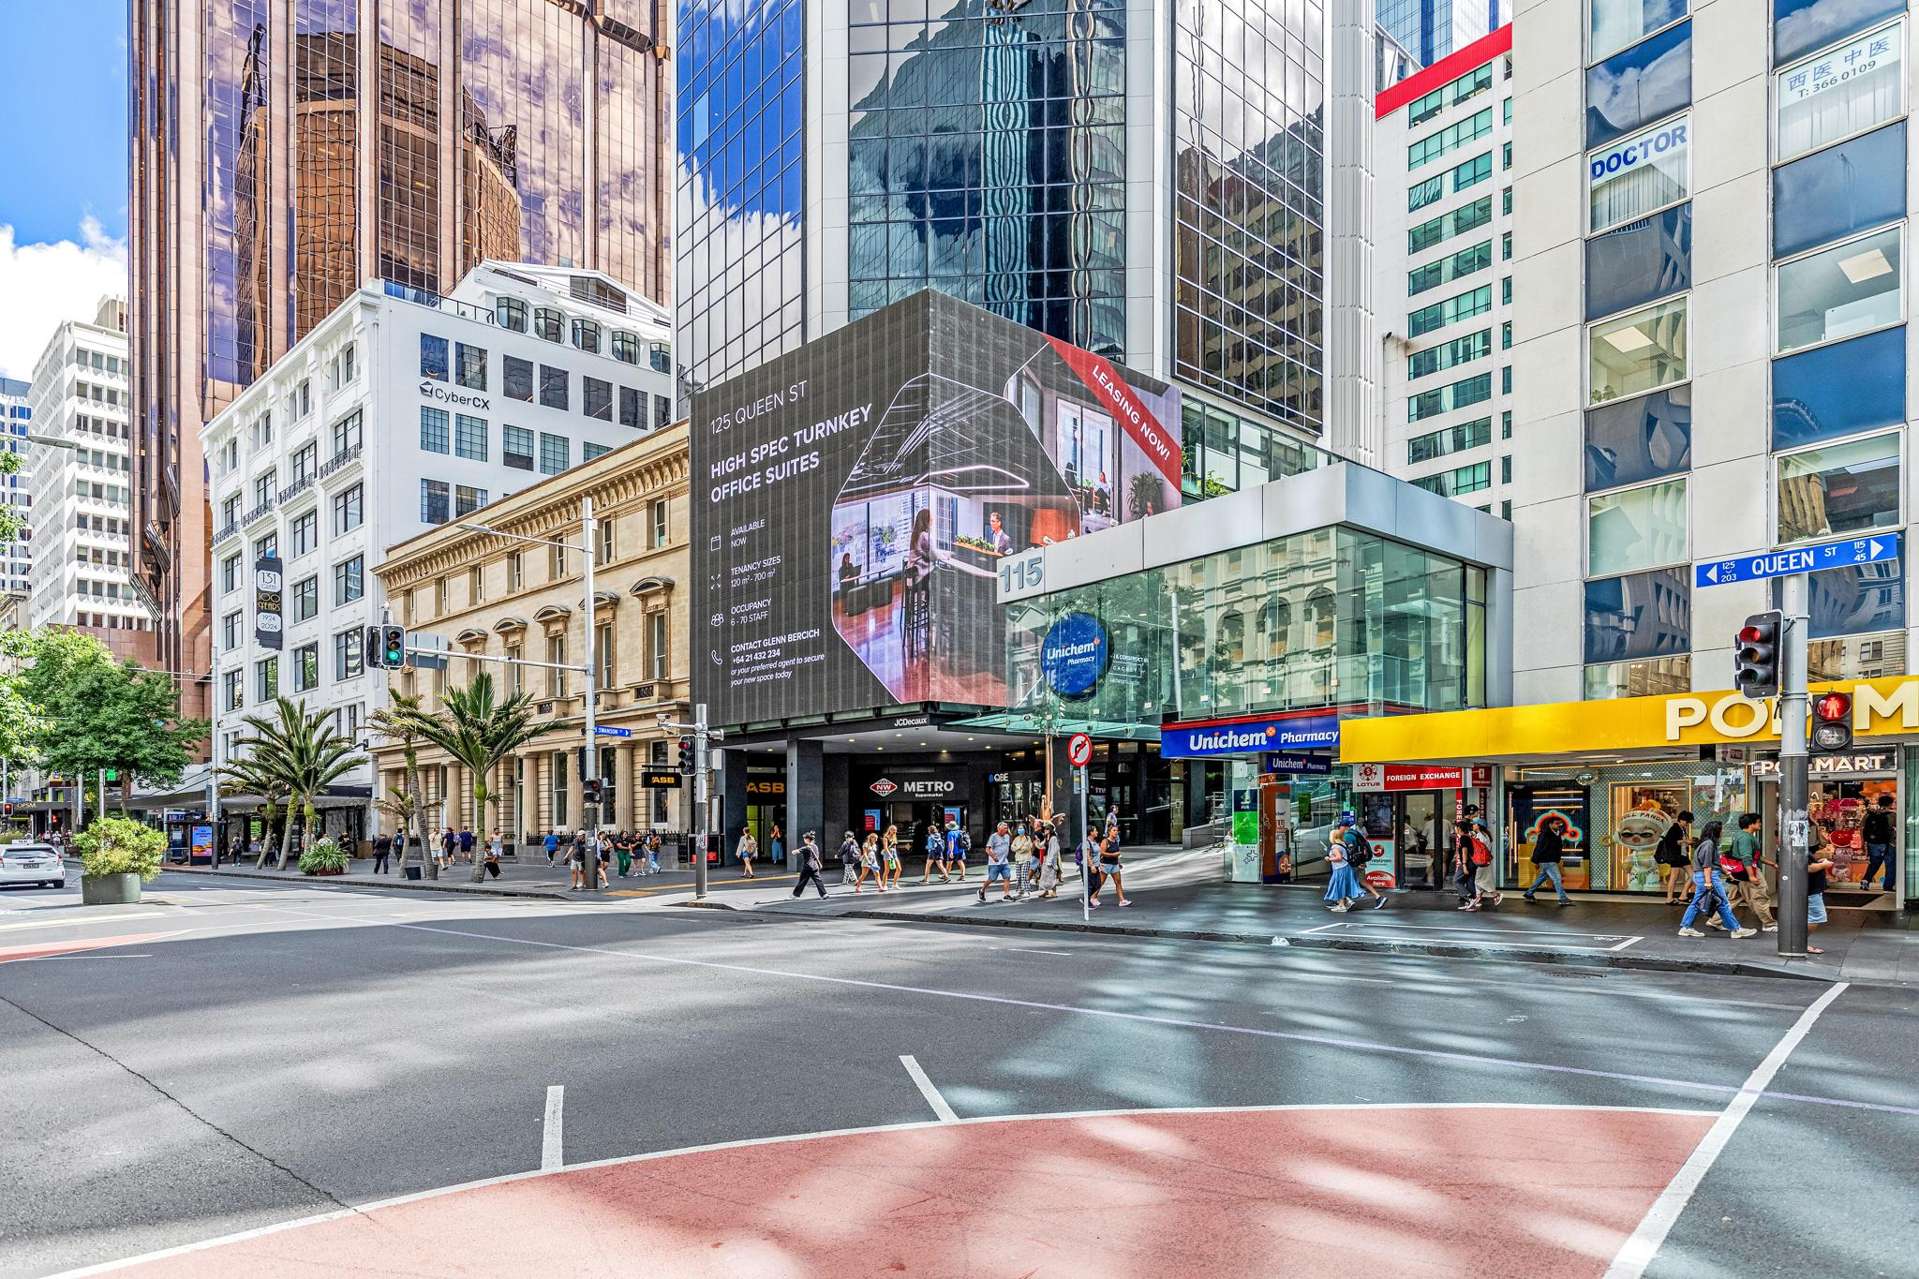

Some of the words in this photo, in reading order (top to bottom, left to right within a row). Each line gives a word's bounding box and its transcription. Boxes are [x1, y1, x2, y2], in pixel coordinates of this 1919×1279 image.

[1787, 61, 1833, 91] 西医
[1844, 36, 1891, 65] 中医
[1798, 88, 1809, 98] T:
[1812, 76, 1838, 93] 366
[1841, 60, 1876, 80] 0109
[1591, 125, 1687, 180] DOCTOR
[435, 388, 490, 410] CyberCX
[710, 413, 731, 435] 125
[735, 390, 784, 424] QUEEN
[789, 380, 808, 402] ST
[1092, 365, 1140, 424] LEASING
[1140, 422, 1170, 460] NOW!
[711, 452, 746, 479] HIGH
[751, 436, 789, 464] SPEC
[793, 403, 872, 448] TURNKEY
[711, 472, 761, 503] OFFICE
[766, 451, 820, 484] SUITES
[731, 519, 766, 536] AVAILABLE
[731, 537, 747, 548] NOW
[1854, 540, 1866, 550] 115
[731, 560, 762, 576] TENANCY
[762, 555, 782, 568] SIZES
[1722, 560, 1736, 570] 125
[1752, 550, 1814, 575] QUEEN
[1824, 546, 1838, 557] ST
[1854, 553, 1866, 561] 45
[262, 572, 277, 584] 131
[731, 578, 740, 588] 120
[754, 571, 766, 582] 700
[1000, 556, 1043, 592] 115
[1720, 574, 1737, 583] 203
[731, 598, 772, 614] OCCUPANCY
[731, 618, 735, 626] 6
[740, 616, 748, 624] 70
[749, 610, 768, 622] STAFF
[731, 640, 761, 653] CONTACT
[763, 635, 786, 648] GLENN
[788, 628, 820, 642] BERCICH
[733, 656, 744, 664] +64
[746, 654, 753, 662] 21
[754, 651, 766, 660] 432
[767, 648, 781, 658] 234
[1047, 642, 1094, 660] Unichem
[737, 667, 750, 676] your
[750, 660, 777, 673] preferred
[778, 660, 796, 669] agent
[804, 654, 825, 663] secure
[1067, 655, 1096, 666] Pharmacy
[731, 677, 743, 688] your
[757, 673, 774, 682] space
[775, 670, 792, 679] today
[894, 718, 927, 727] JCDecaux
[1190, 730, 1267, 750] Unichem
[1280, 731, 1338, 744] Pharmacy
[1272, 757, 1303, 769] Unichem
[1306, 762, 1327, 771] Pharmacy
[1816, 755, 1886, 772] MART
[994, 773, 1009, 782] QBE
[1386, 774, 1416, 782] FOREIGN
[1420, 772, 1460, 780] EXCHANGE
[746, 782, 785, 793] ASB
[904, 781, 954, 792] METRO
